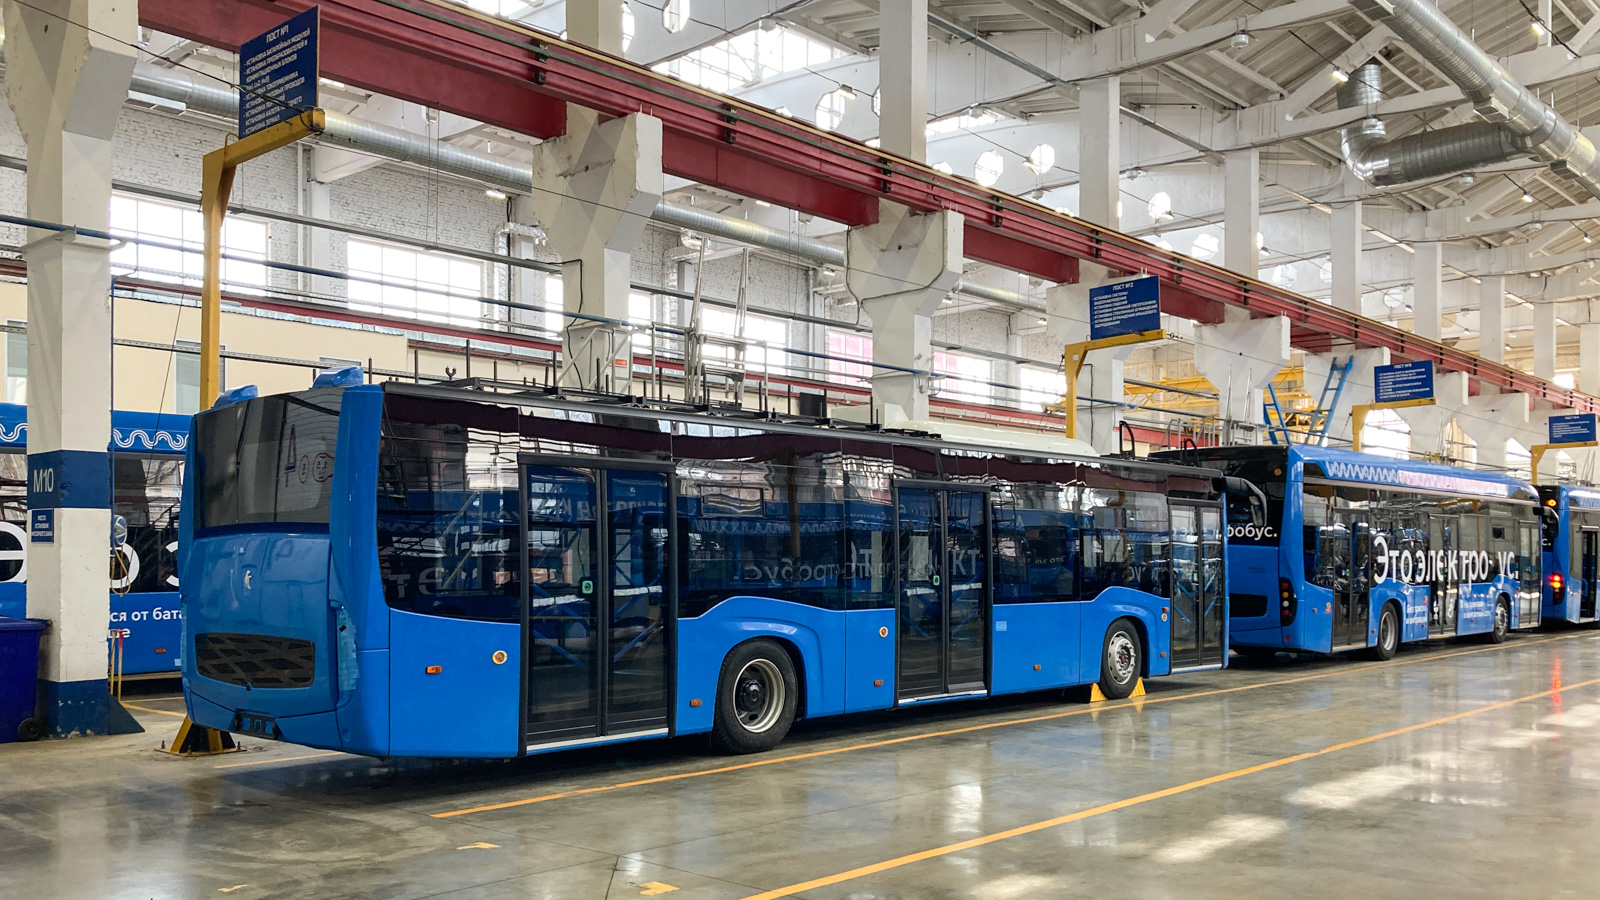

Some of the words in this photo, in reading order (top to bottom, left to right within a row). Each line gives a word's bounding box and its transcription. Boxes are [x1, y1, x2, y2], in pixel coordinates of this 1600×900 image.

[266, 29, 280, 43] ПОСТ
[280, 24, 289, 36] №1
[1112, 283, 1125, 291] ПОСТ
[33, 468, 54, 493] М10
[1373, 535, 1413, 584] Это
[131, 611, 149, 621] от
